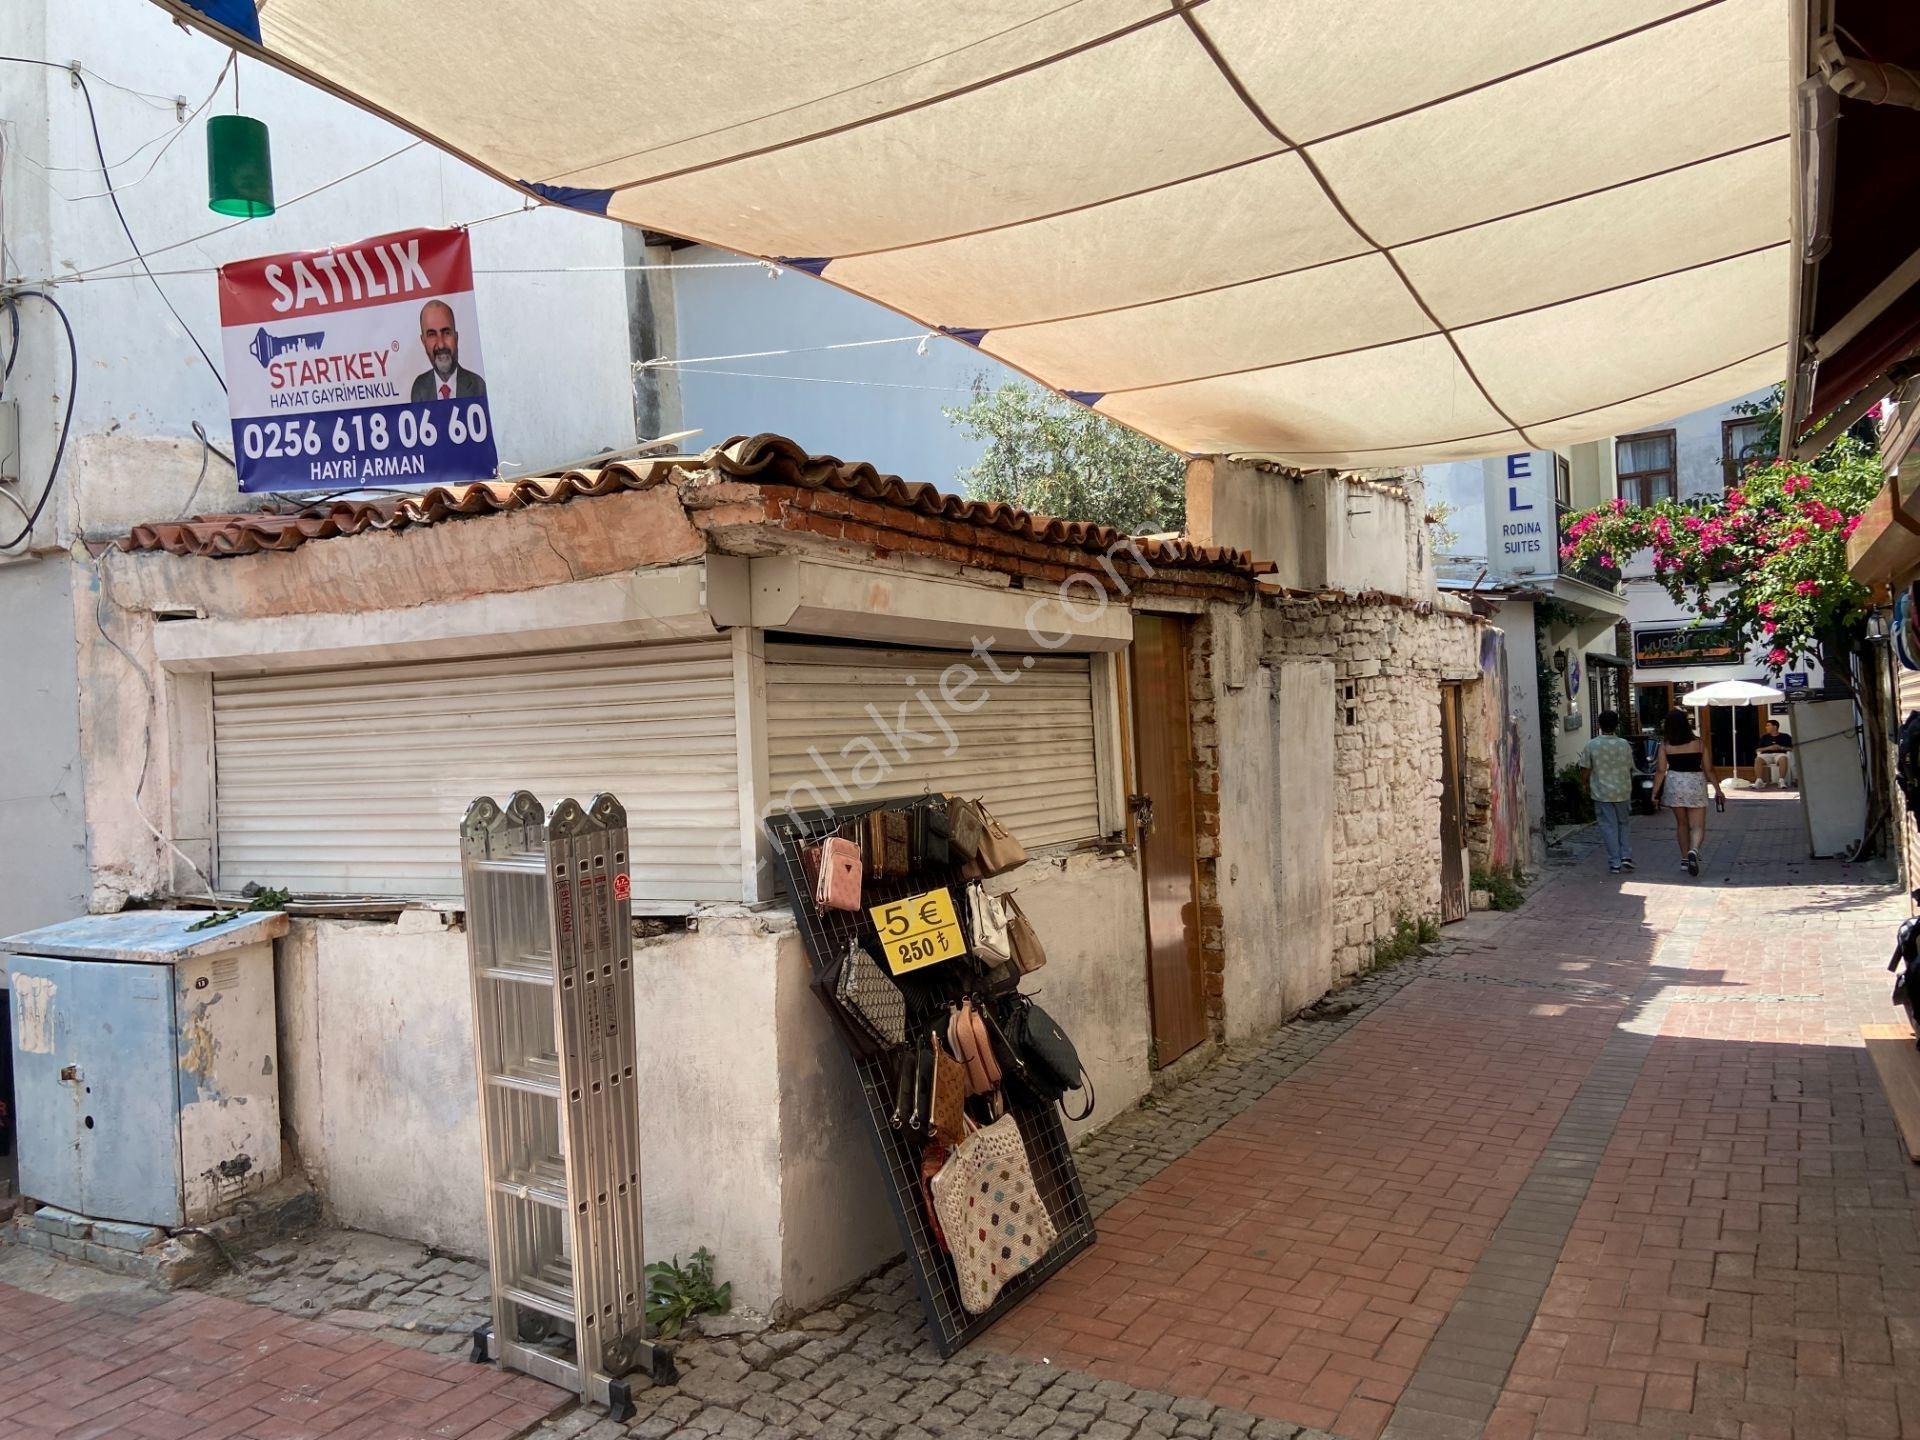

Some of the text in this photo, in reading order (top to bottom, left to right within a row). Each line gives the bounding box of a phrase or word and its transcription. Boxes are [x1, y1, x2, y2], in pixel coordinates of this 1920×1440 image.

[265, 239, 431, 313] SATILIK
[270, 350, 390, 389] STARTKEY
[270, 382, 400, 408] HAYAT GAYRİMENKUL
[243, 403, 487, 460] 0256 618 06 60
[310, 454, 425, 480] HAYRİ ARMAN
[1504, 539, 1541, 554] SUITES
[885, 900, 943, 936] 5 €
[898, 937, 934, 965] 250
